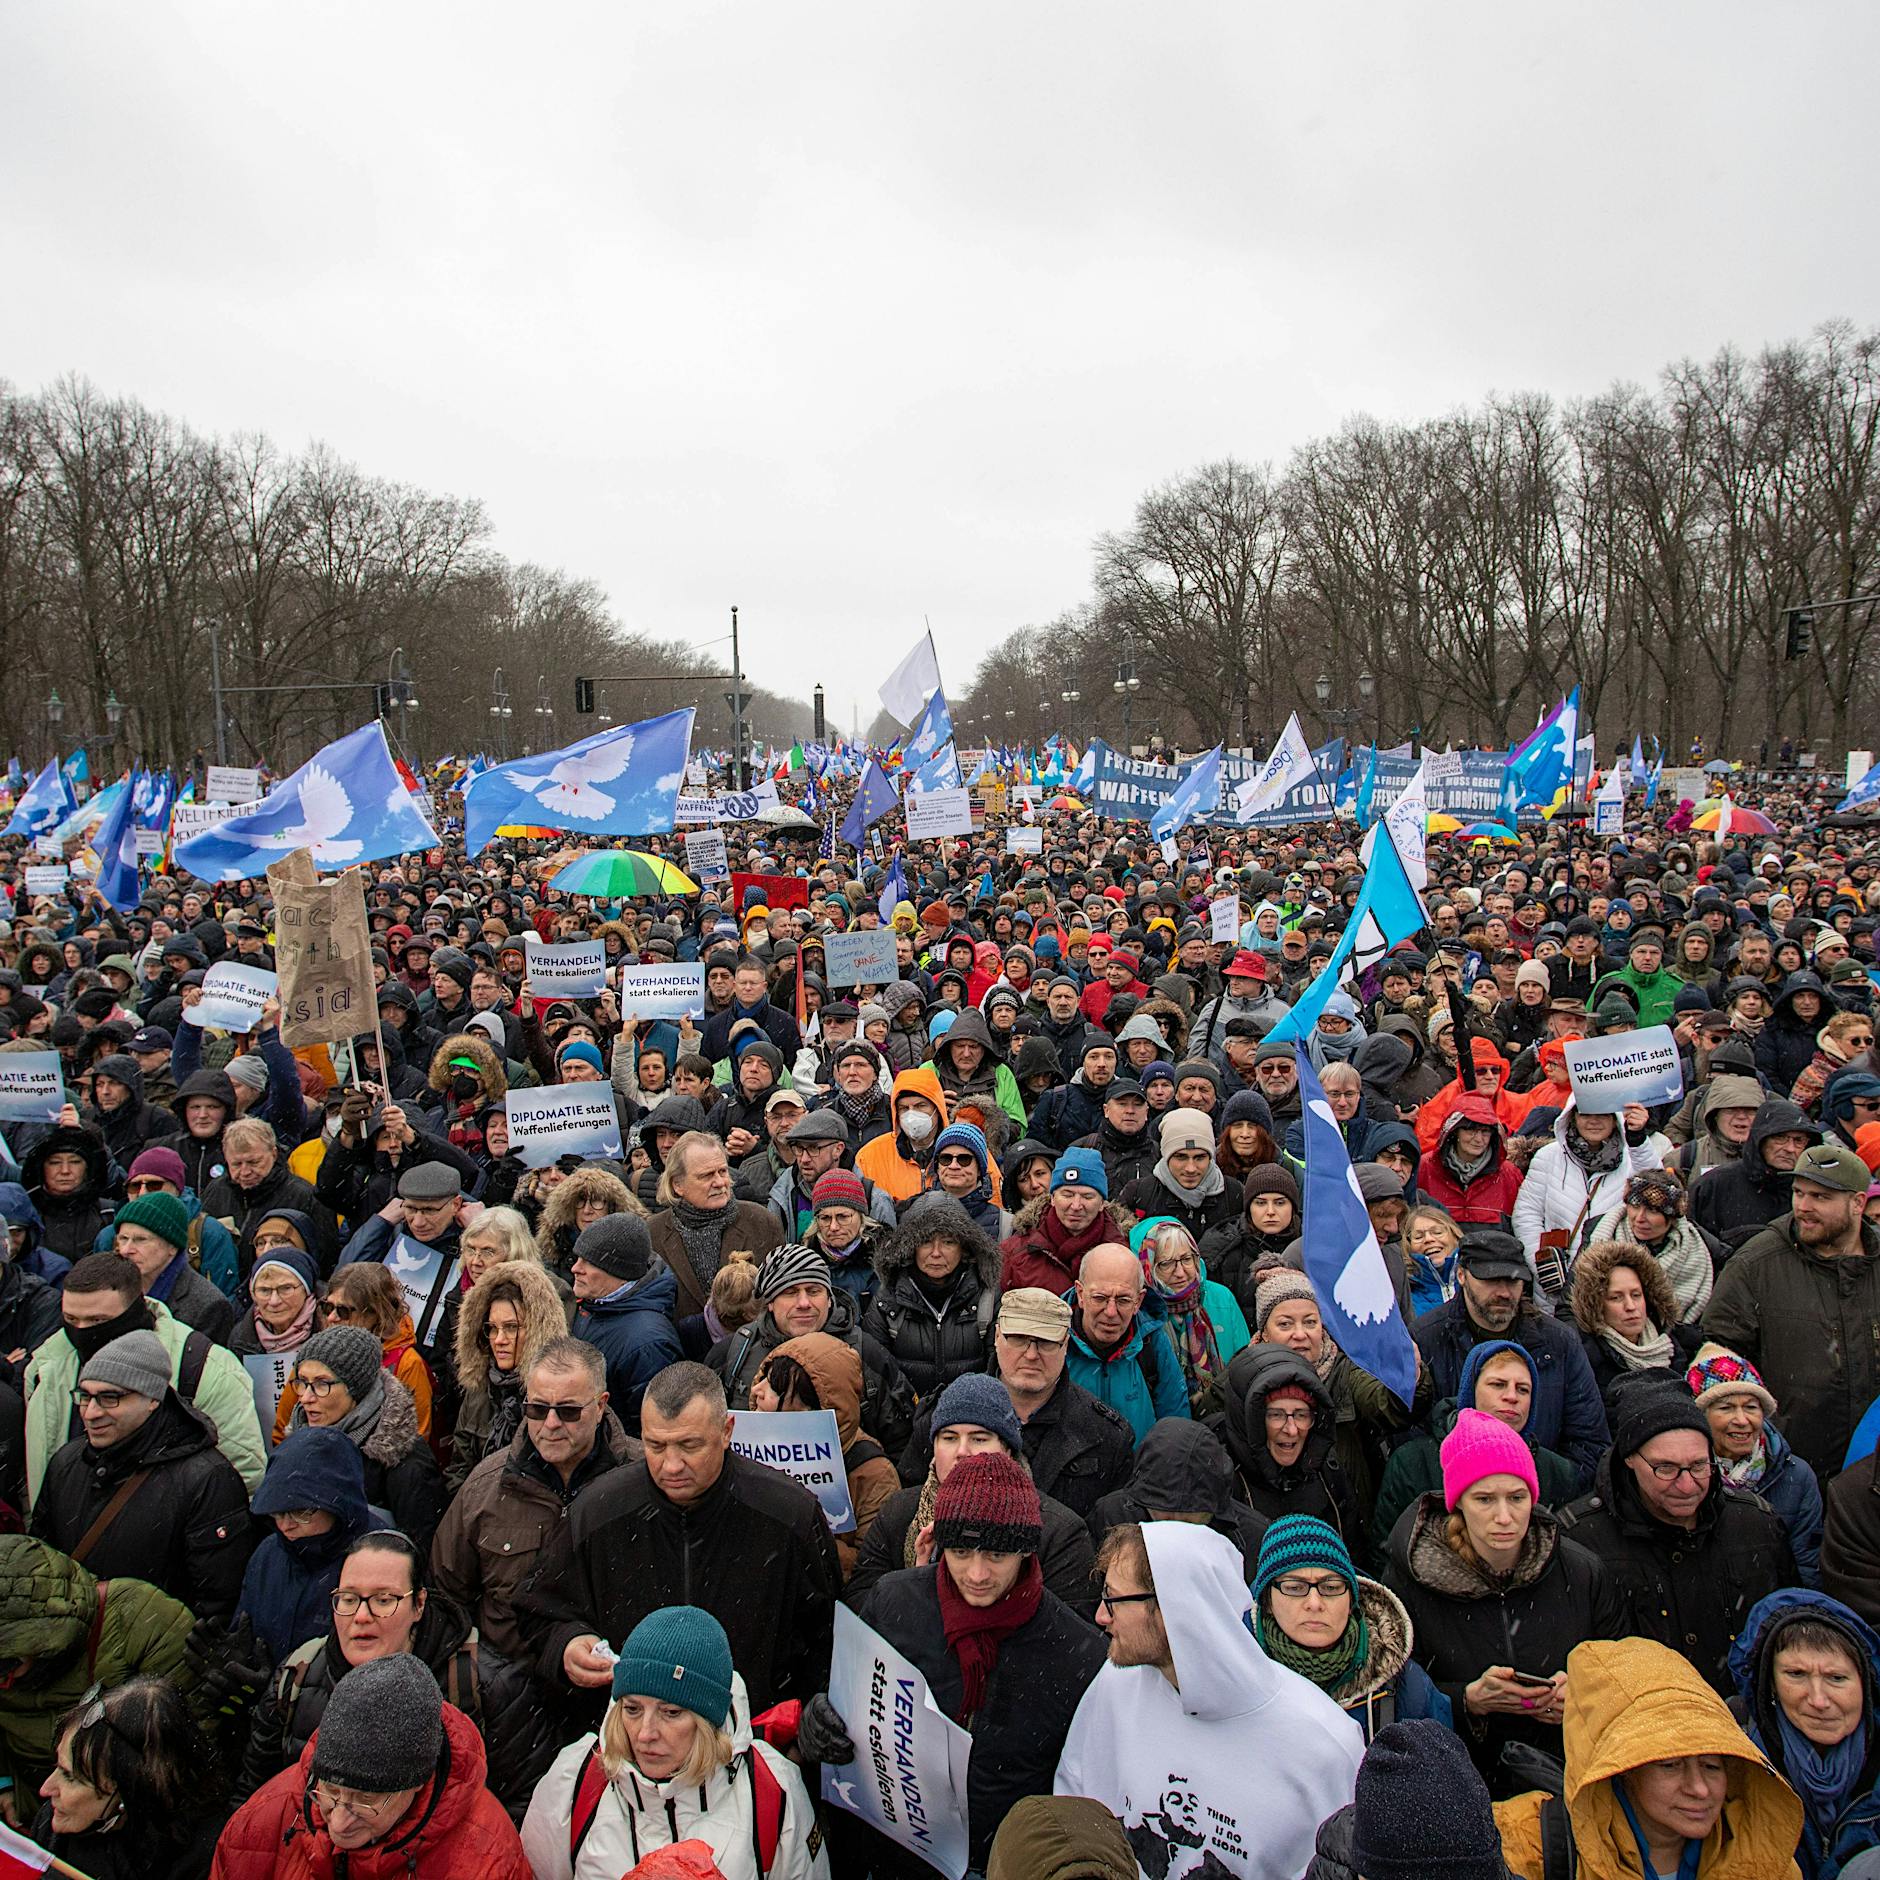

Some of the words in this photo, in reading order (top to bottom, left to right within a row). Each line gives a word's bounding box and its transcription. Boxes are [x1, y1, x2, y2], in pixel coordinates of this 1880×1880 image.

[1104, 749, 1184, 782] FRIEDEN,
[1472, 777, 1501, 789] GEGEN
[1292, 782, 1338, 807] TOD!
[530, 954, 601, 967] VERHANDELN
[531, 968, 553, 977] statt
[556, 967, 601, 977] eskalieren
[628, 976, 700, 986] VERHANDELN
[248, 987, 270, 999] statt
[629, 989, 650, 997] statt
[652, 987, 698, 997] eskalieren
[1574, 1051, 1648, 1072] DIPLOMATIE
[1650, 1048, 1674, 1060] statt
[30, 1073, 57, 1082] statt
[1576, 1062, 1674, 1084] Waffenlieferungen
[512, 1106, 584, 1123] DIPLOMATIE
[586, 1104, 611, 1114] statt
[514, 1119, 612, 1136] Waffenlieferungen
[274, 1360, 285, 1390] statt
[869, 1657, 888, 1723] statt
[894, 1678, 933, 1845] VERHANDELN
[869, 1724, 898, 1824] eskalieren
[1206, 1806, 1236, 1828] THERE
[1226, 1831, 1242, 1844] NO
